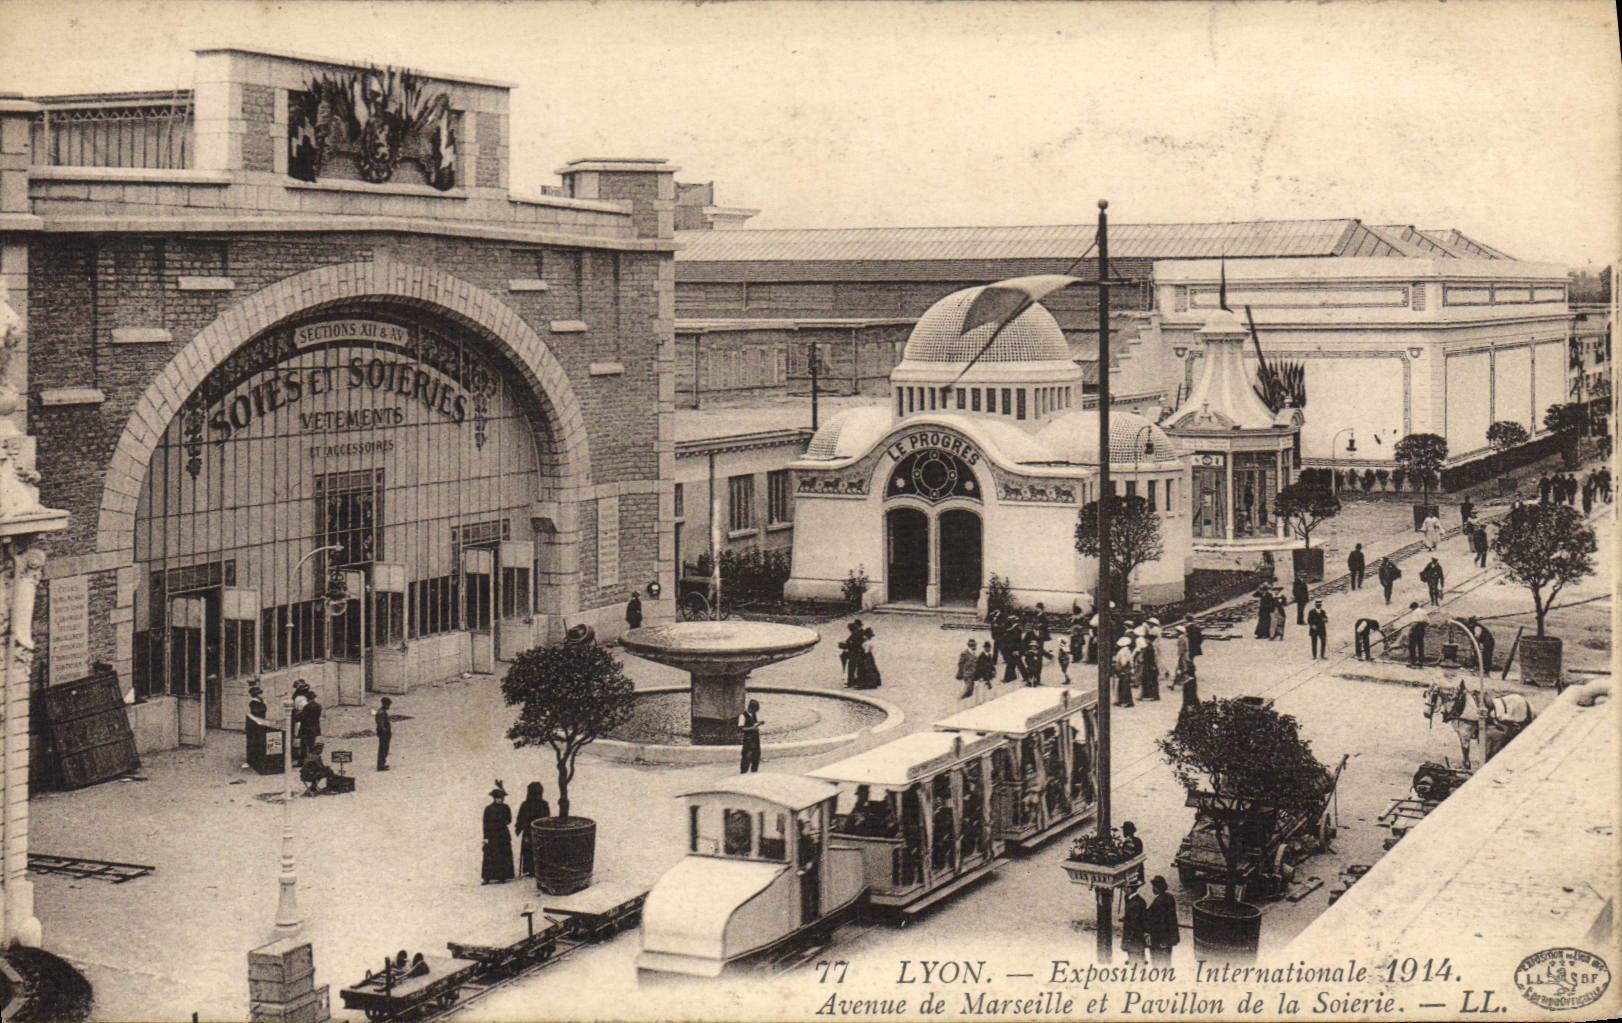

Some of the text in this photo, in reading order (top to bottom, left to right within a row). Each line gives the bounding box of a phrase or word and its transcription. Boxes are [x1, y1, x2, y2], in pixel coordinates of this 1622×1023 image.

[300, 323, 356, 343] SECTIONS
[361, 324, 377, 337] XII
[381, 327, 388, 338] &
[208, 357, 466, 446] SOIES ET SOIERIES
[299, 407, 403, 430] VETEMENTS
[325, 440, 394, 457] ACCESSOIRES
[887, 432, 980, 466] LE PROGRES
